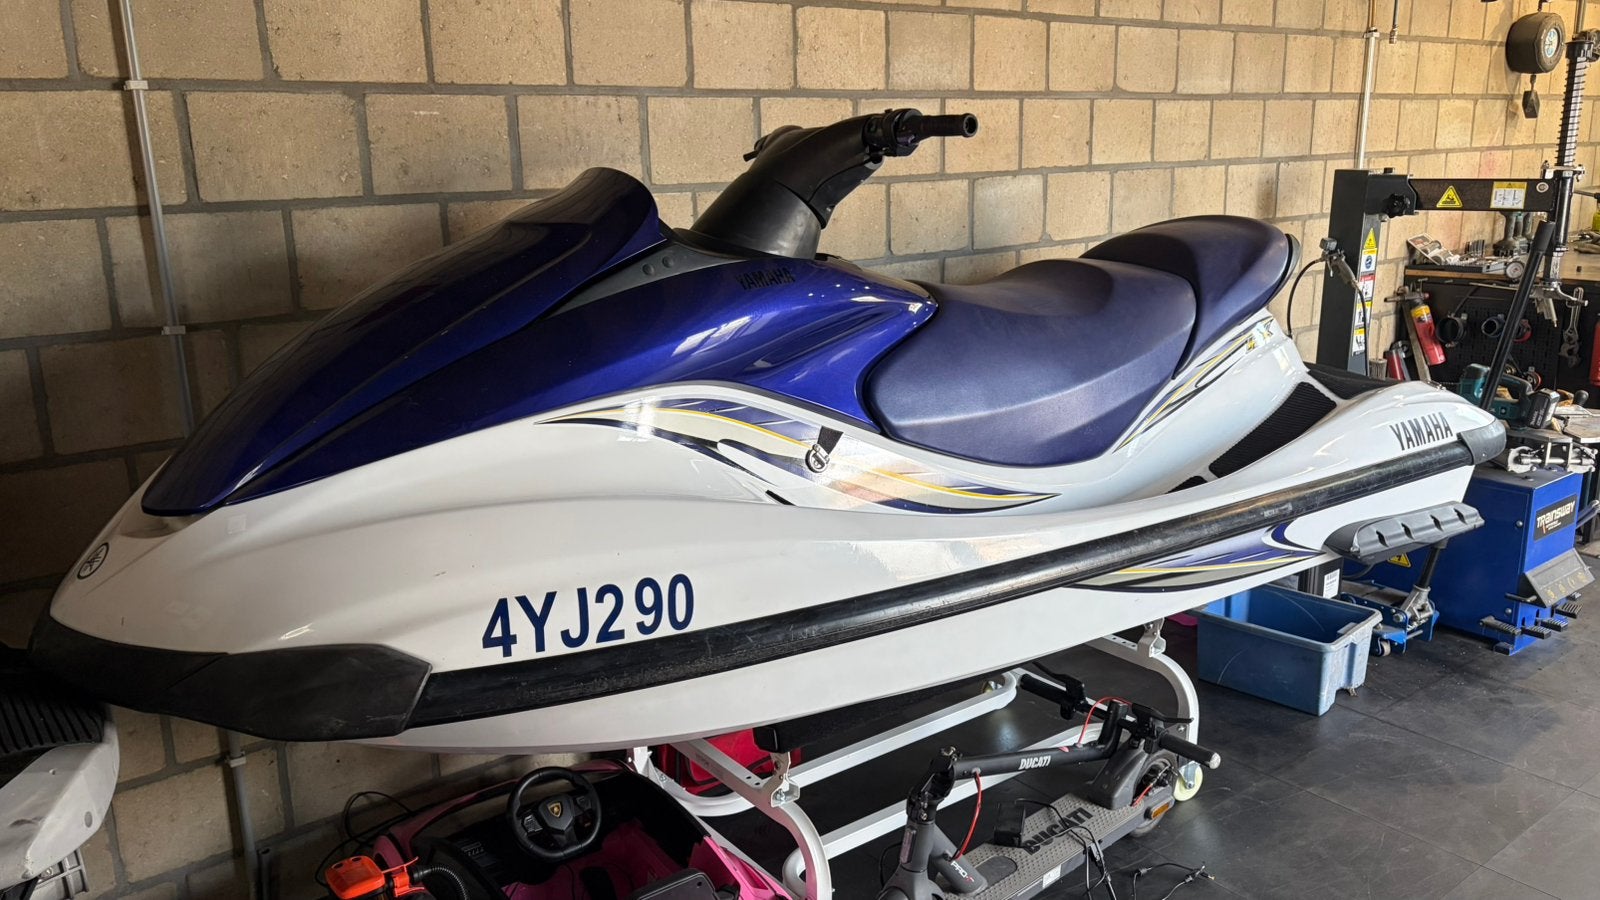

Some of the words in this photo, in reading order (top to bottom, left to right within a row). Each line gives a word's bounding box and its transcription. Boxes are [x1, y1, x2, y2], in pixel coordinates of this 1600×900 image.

[736, 267, 796, 290] YAMAHA
[1389, 412, 1453, 451] YAMAHA
[482, 573, 694, 658] 4YJ290
[1018, 755, 1051, 770] DUCATI
[1022, 807, 1094, 856] DUCATI
